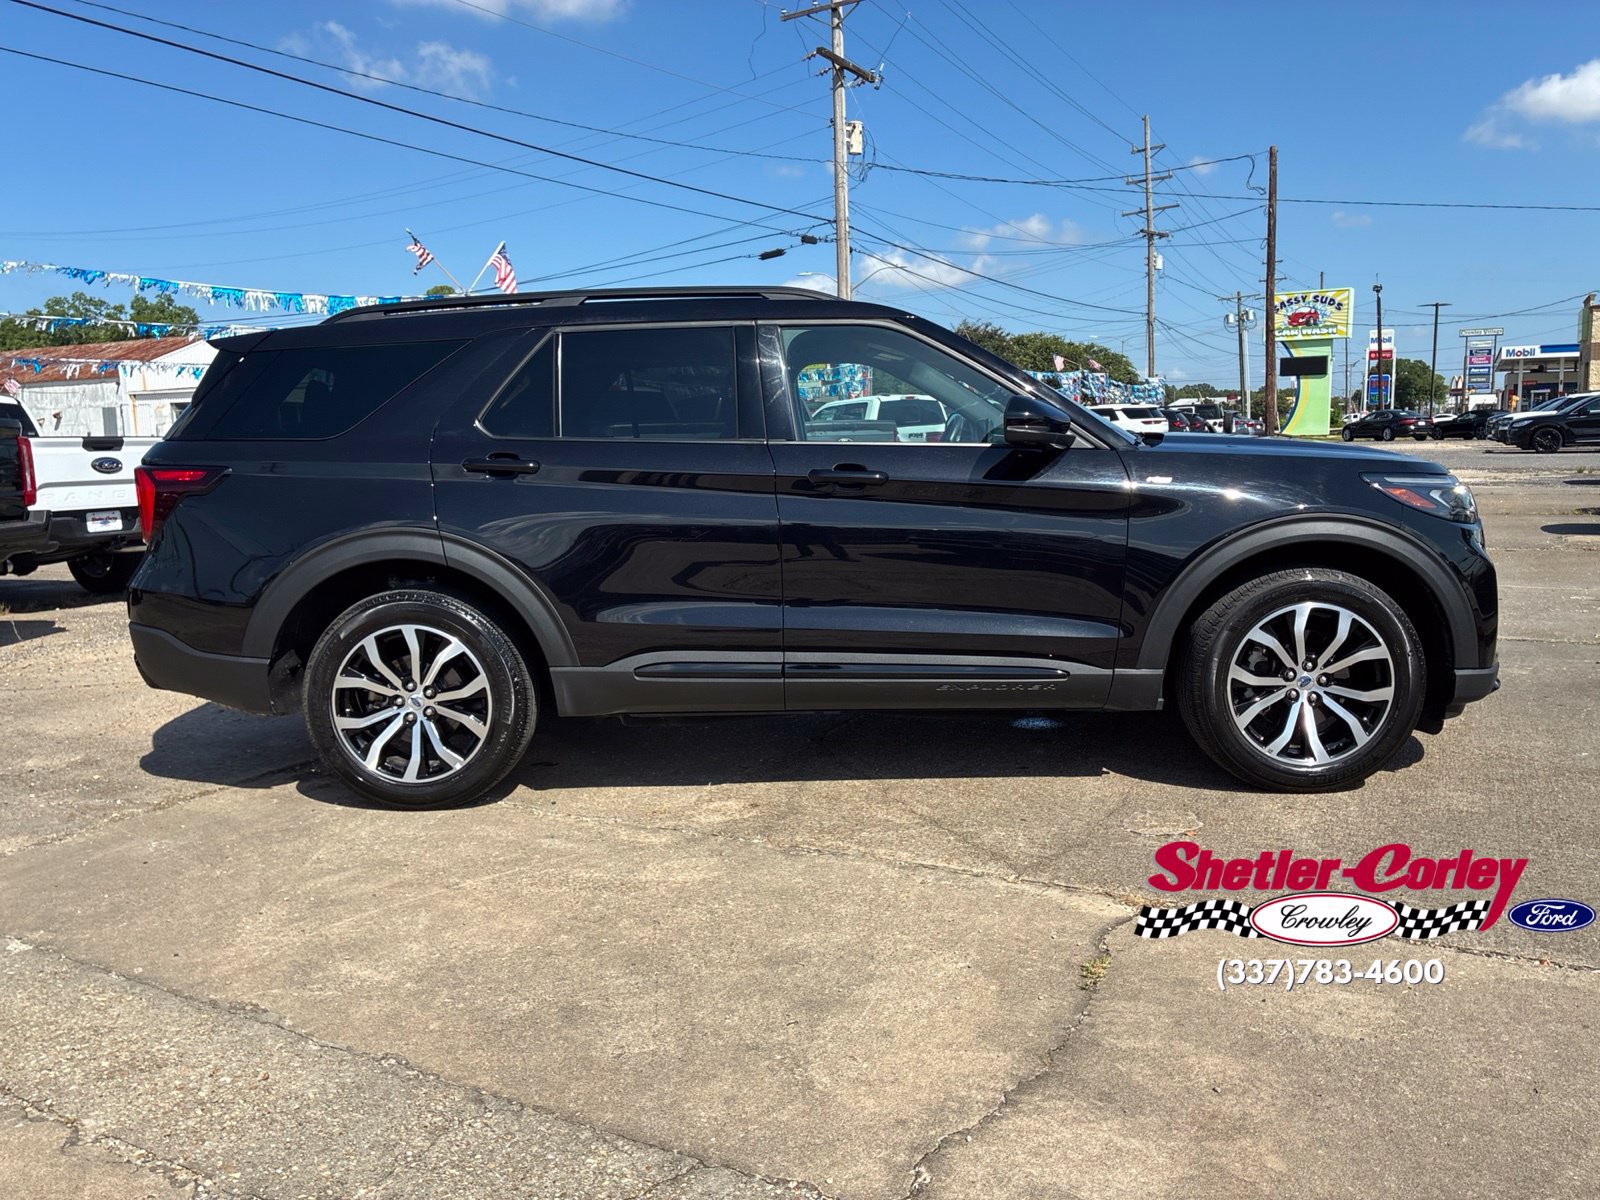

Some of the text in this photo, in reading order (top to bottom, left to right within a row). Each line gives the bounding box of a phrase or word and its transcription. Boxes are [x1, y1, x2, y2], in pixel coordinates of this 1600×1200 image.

[1274, 294, 1344, 313] SASSY SUDS
[1275, 324, 1337, 337] CAR WASH
[1370, 336, 1392, 344] Mbil
[1505, 348, 1536, 358] Mobil
